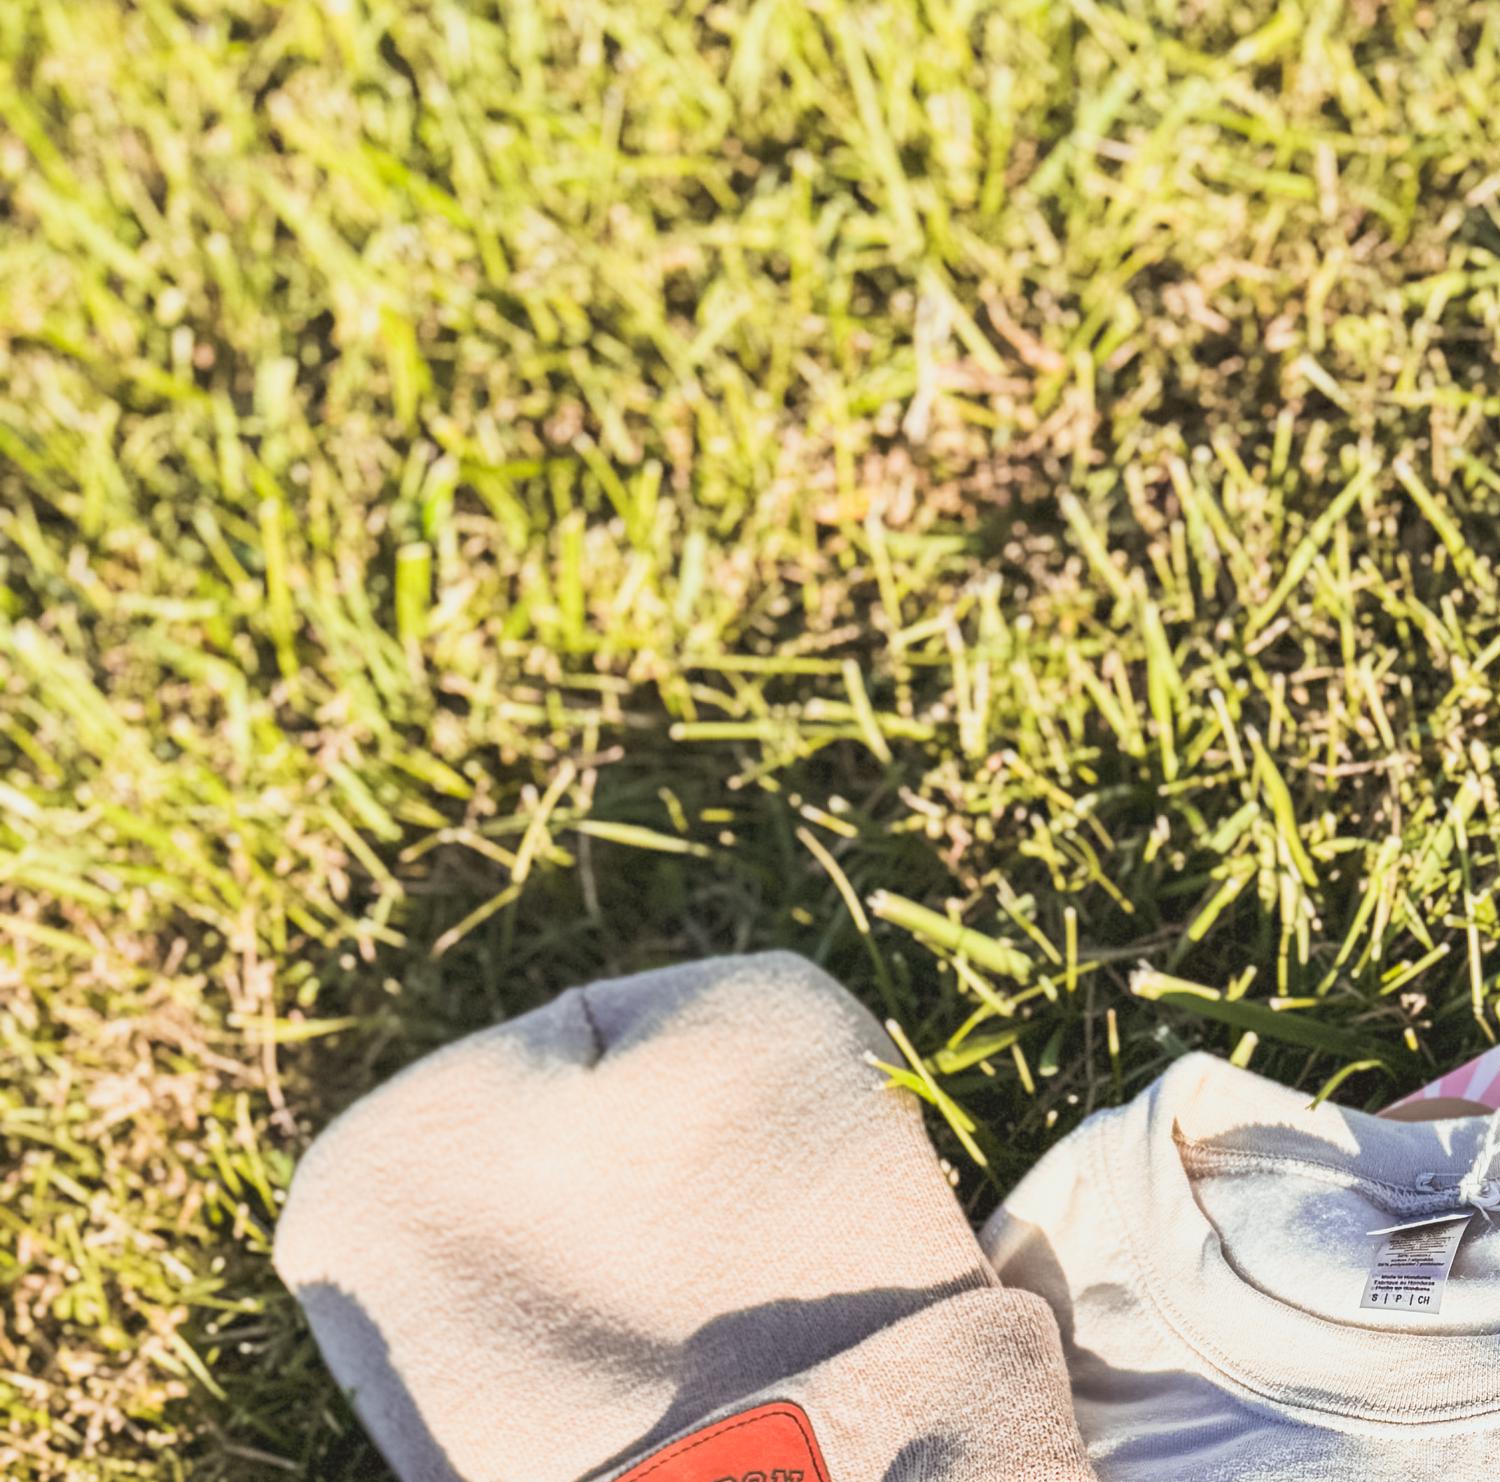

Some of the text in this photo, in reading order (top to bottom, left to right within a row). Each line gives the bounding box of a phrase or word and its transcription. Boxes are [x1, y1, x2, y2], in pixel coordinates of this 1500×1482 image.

[1371, 1293, 1378, 1302] S
[1395, 1294, 1402, 1303] P
[1417, 1295, 1430, 1305] CH
